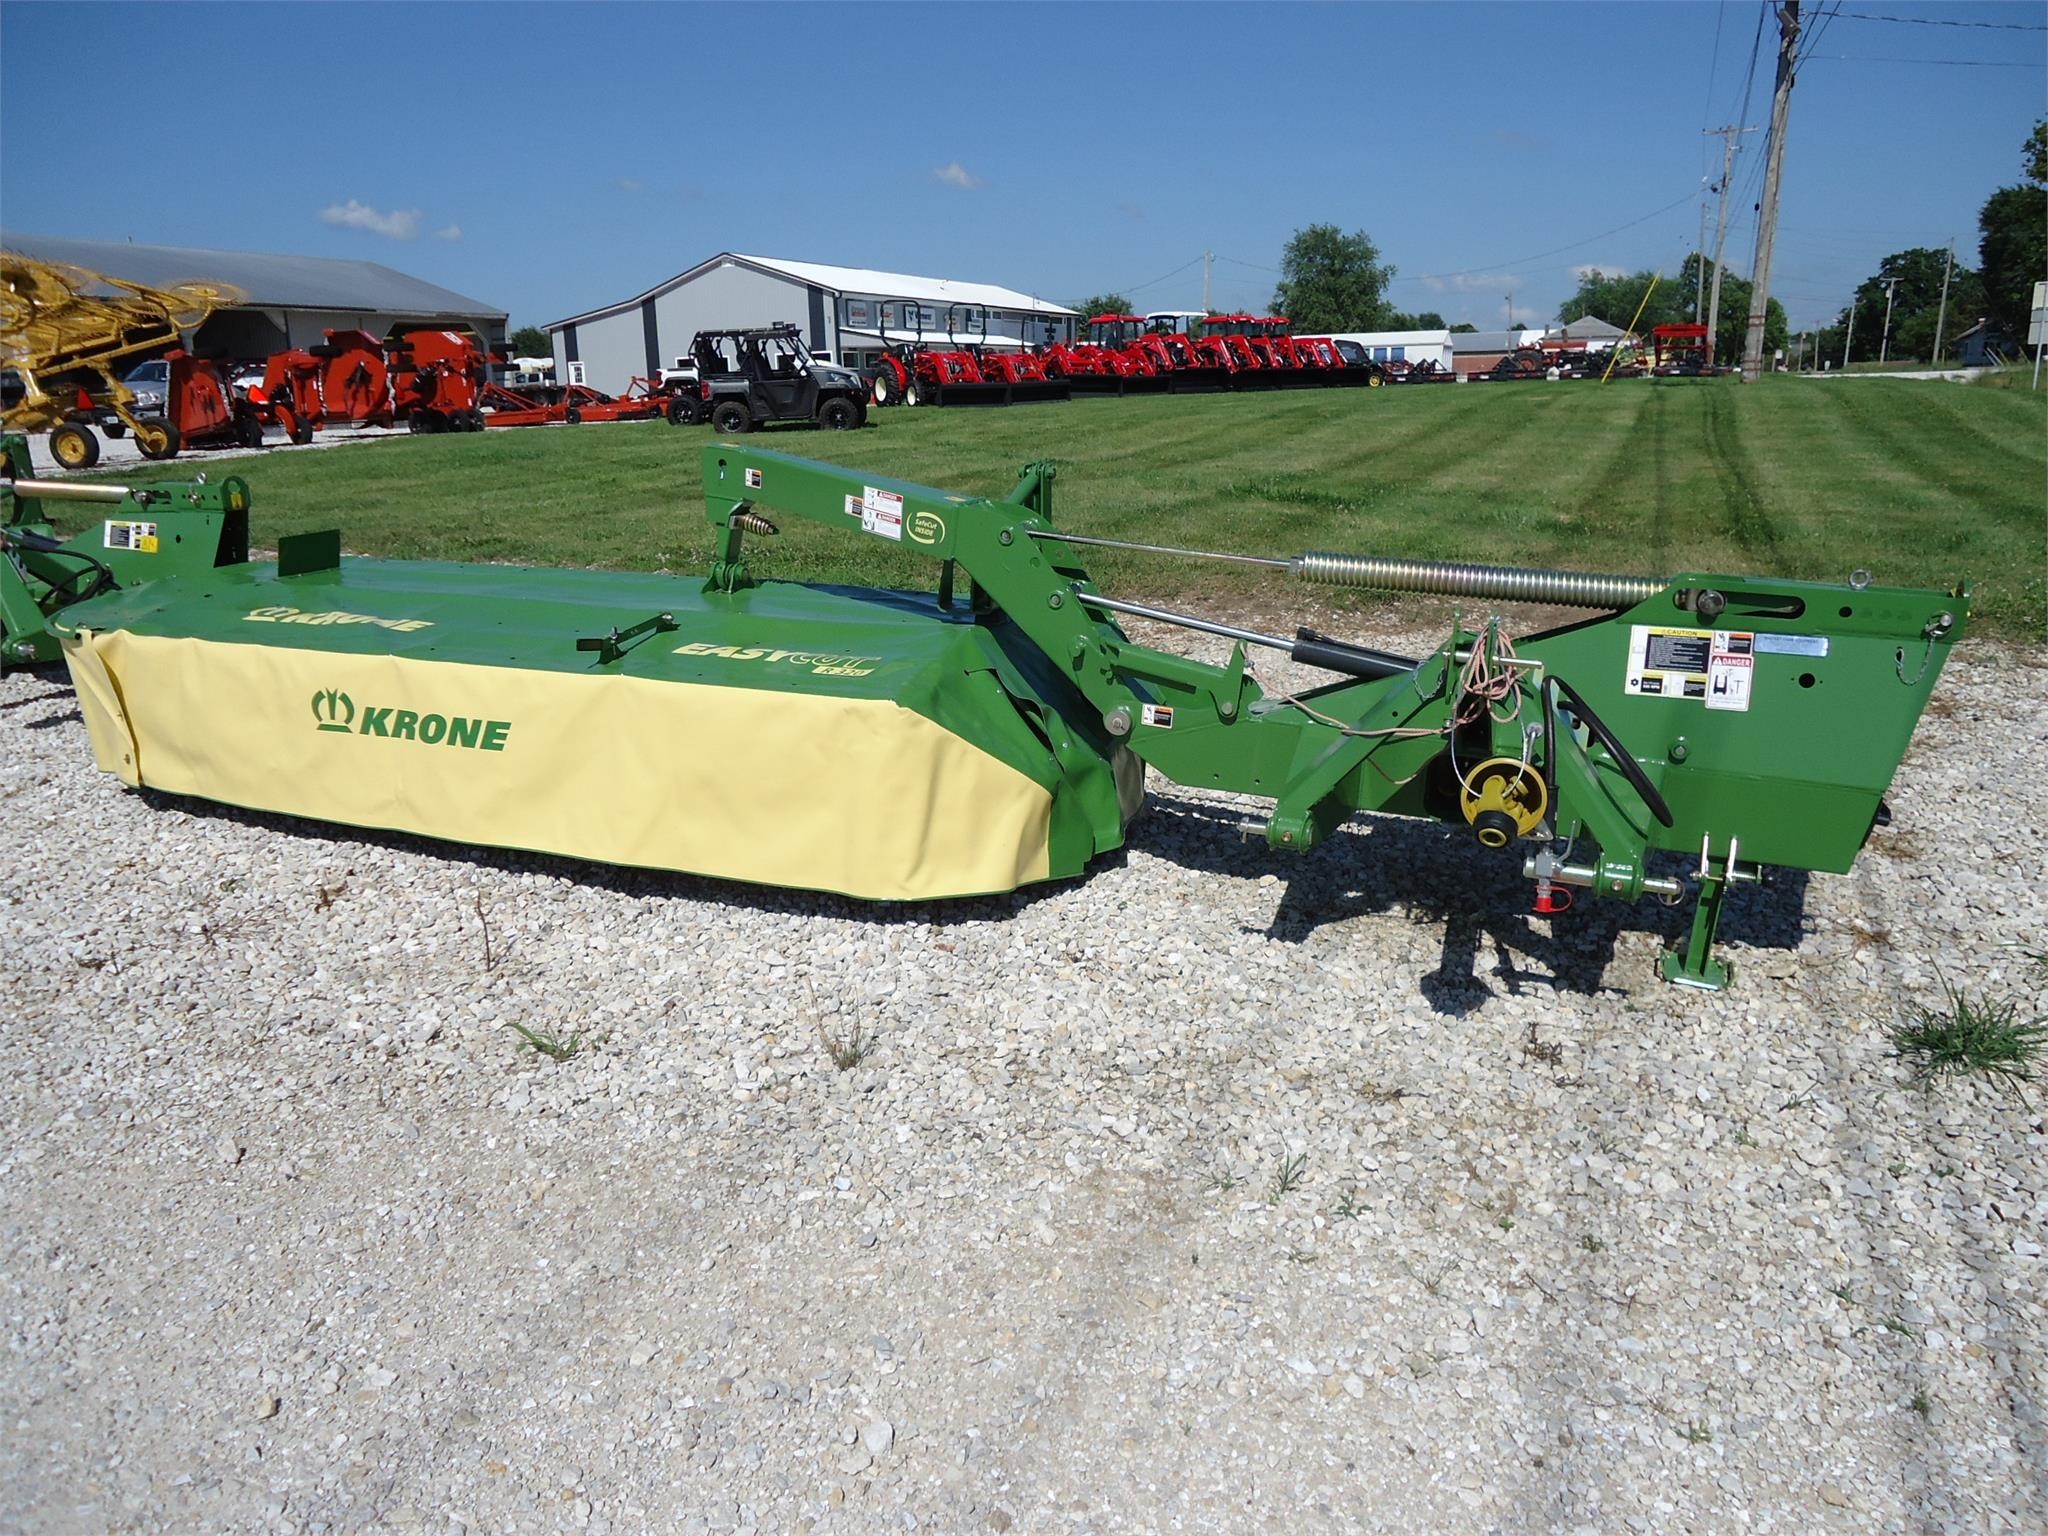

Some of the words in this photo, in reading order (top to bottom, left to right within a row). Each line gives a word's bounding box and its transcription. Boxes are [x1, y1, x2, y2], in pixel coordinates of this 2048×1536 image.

[915, 519, 937, 530] SafeCut
[1722, 657, 1751, 667] DANGER
[359, 706, 512, 751] KRONE
